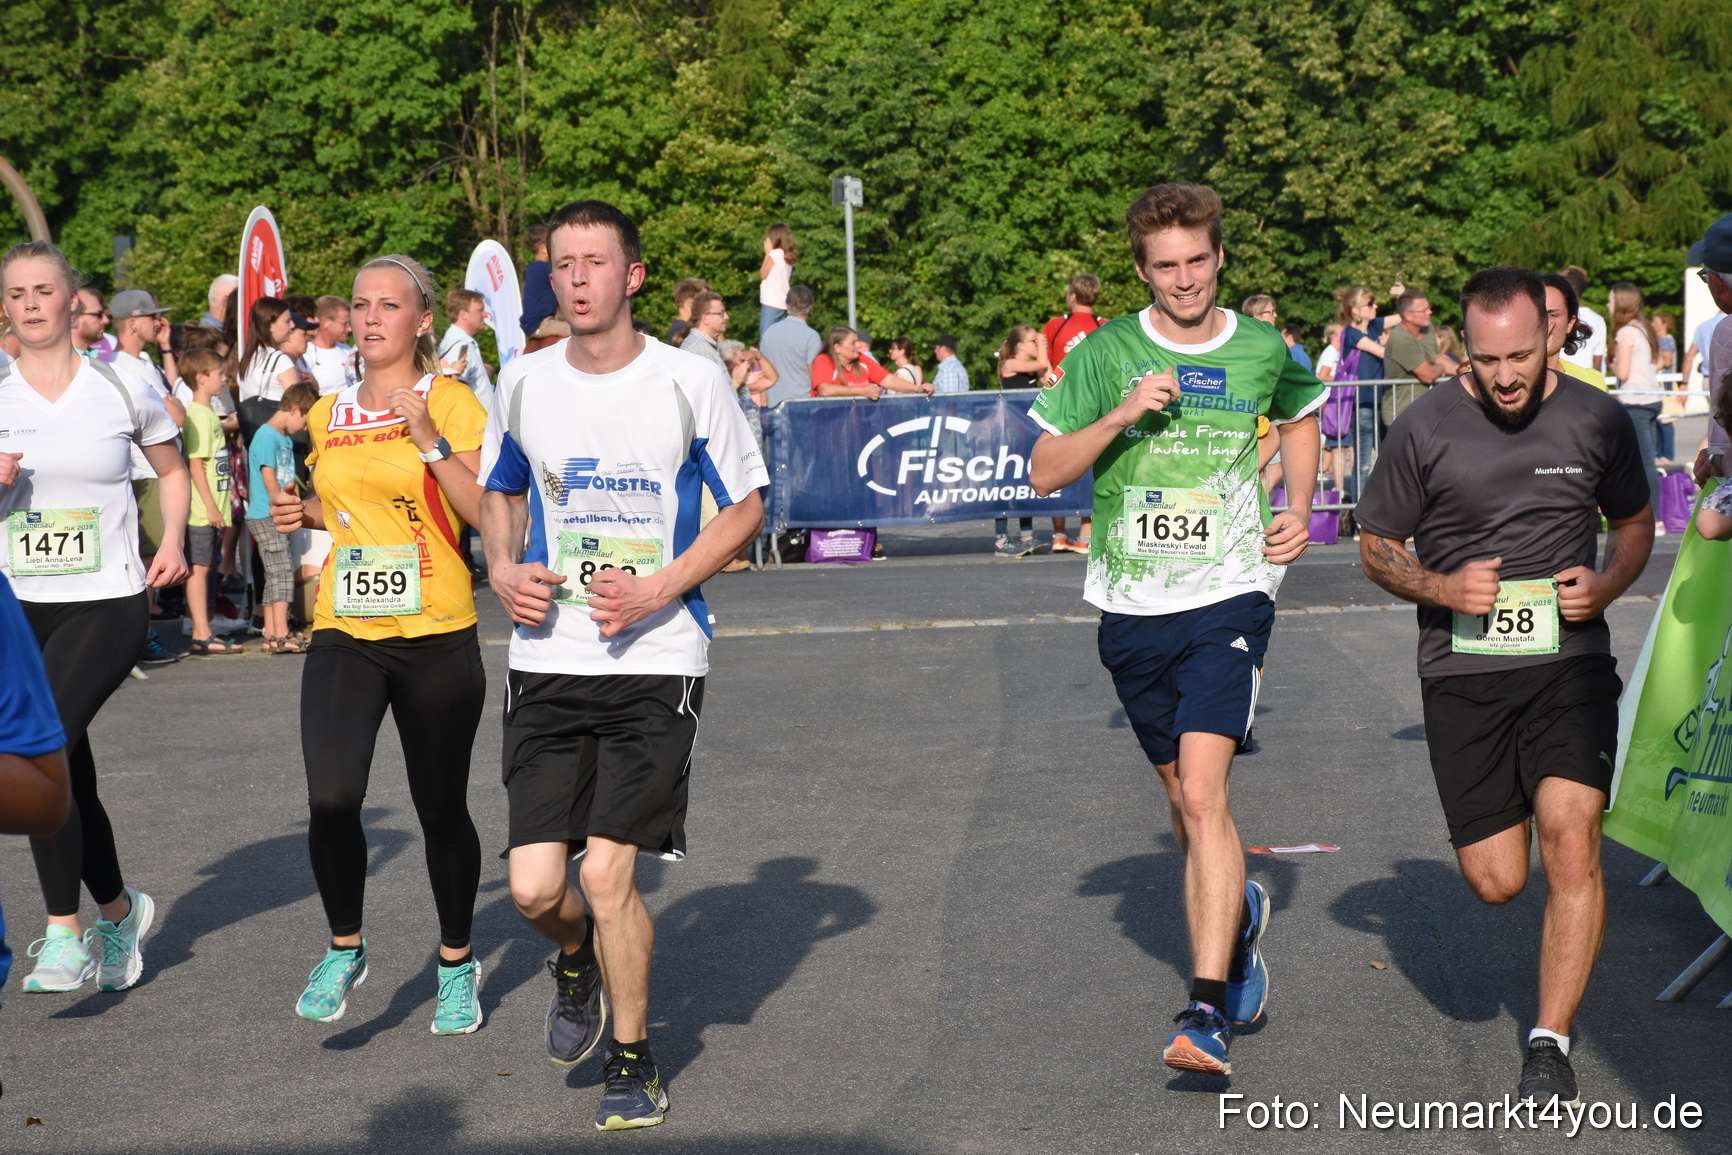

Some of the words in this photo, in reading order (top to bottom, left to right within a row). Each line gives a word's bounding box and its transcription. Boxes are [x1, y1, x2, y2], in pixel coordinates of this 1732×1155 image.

[1188, 376, 1223, 386] Fischer
[1125, 424, 1188, 438] Gesunde
[1196, 425, 1251, 439] Firmen
[324, 433, 367, 450] MAX
[1150, 440, 1200, 455] laufen
[897, 445, 1032, 484] Fisch
[558, 457, 662, 506] FORSTER
[1138, 500, 1176, 509] firmenlauf
[20, 521, 55, 529] firmenlauf
[1136, 513, 1210, 542] 1634
[20, 531, 84, 556] 1471
[1137, 540, 1182, 550] Miaskiwskyi
[573, 547, 613, 558] firmenlauf
[636, 557, 655, 565] 2019
[343, 570, 407, 596] 1559
[1476, 608, 1535, 634] 158
[1476, 634, 1501, 642] Gören
